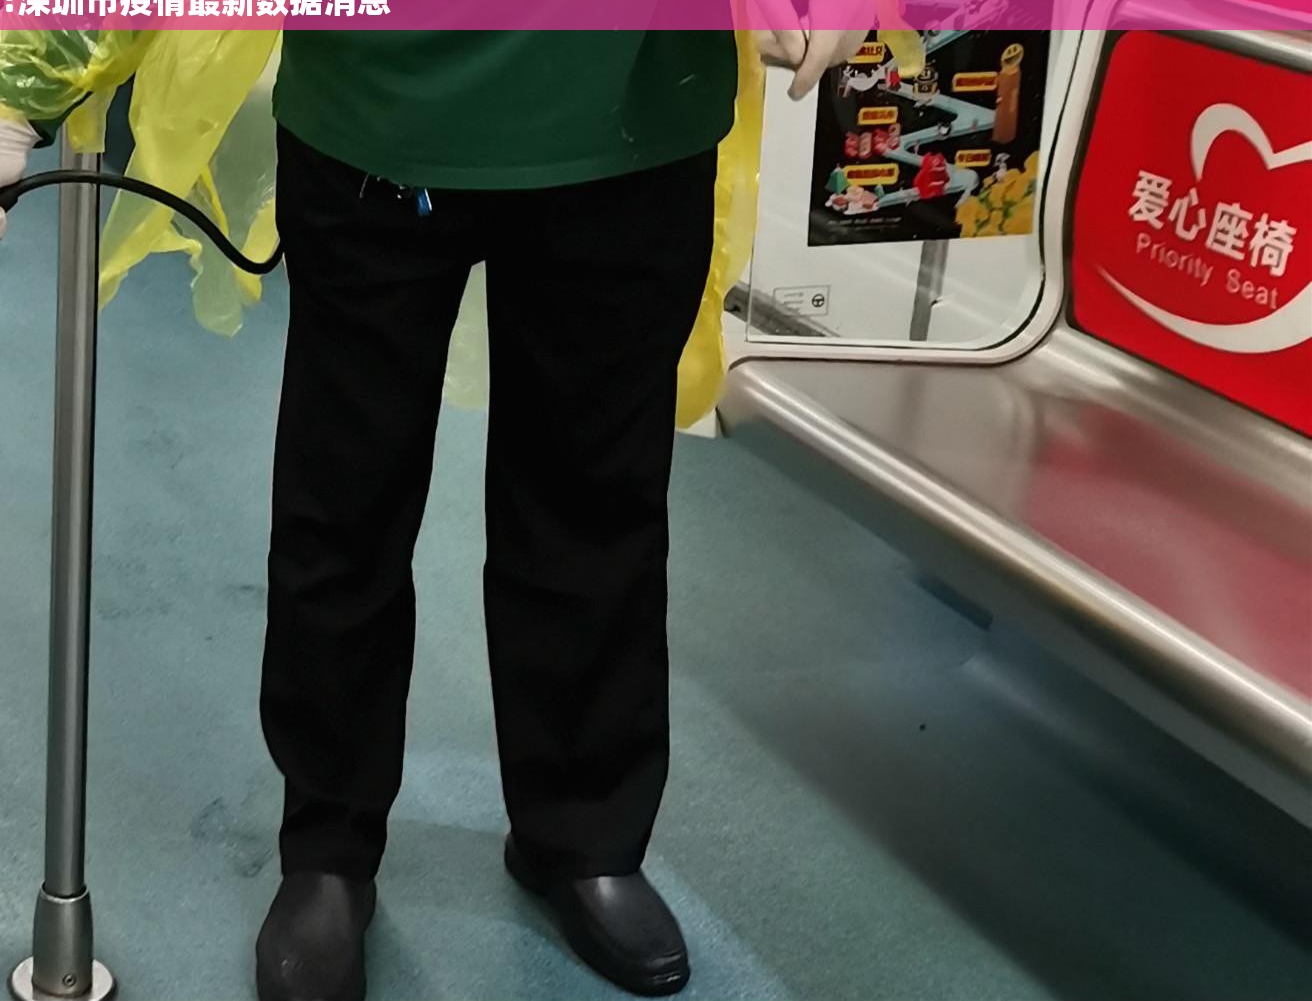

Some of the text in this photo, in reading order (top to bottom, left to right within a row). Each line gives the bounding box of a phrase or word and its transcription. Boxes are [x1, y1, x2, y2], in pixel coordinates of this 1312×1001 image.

[1128, 170, 1298, 277] 爱心座椅
[1137, 232, 1279, 309] Priority Seat
